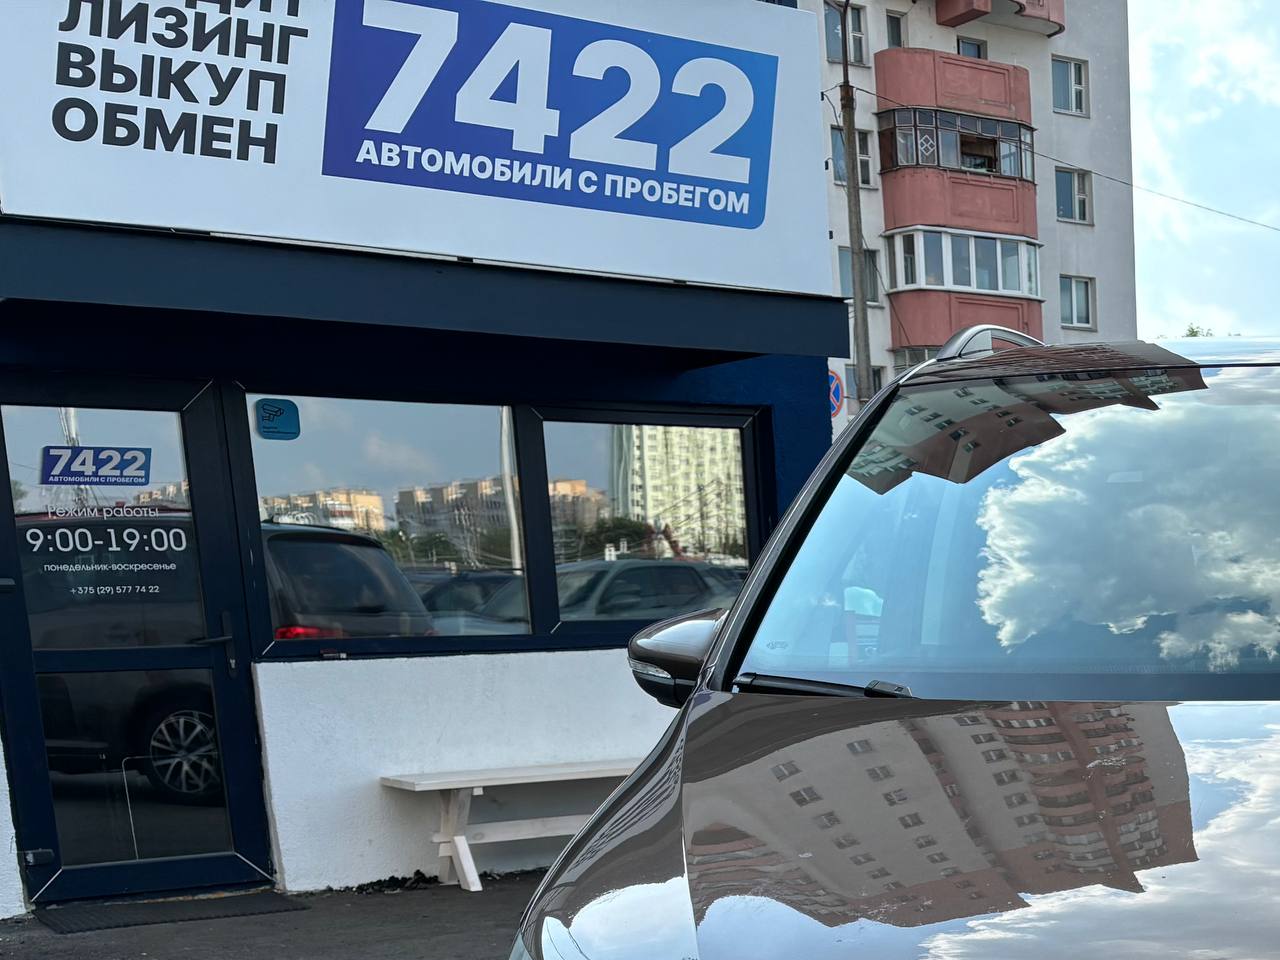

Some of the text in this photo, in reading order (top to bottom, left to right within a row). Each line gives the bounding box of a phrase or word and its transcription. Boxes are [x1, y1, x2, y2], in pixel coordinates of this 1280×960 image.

[58, 0, 309, 65] ЛИЗИНГ
[55, 41, 287, 115] ВЫКУП
[361, 0, 755, 184] 7422
[51, 97, 279, 164] ОБМЕН
[355, 139, 750, 215] АВТОМОБИЛИ С ПРОБЕГОМ
[49, 448, 146, 476] 7422
[47, 504, 160, 520] Режим работы
[25, 527, 188, 552] 9:00-19:00
[43, 562, 177, 572] понедельник-воскресенье
[70, 585, 160, 595] +375 (29) 577 74 22
